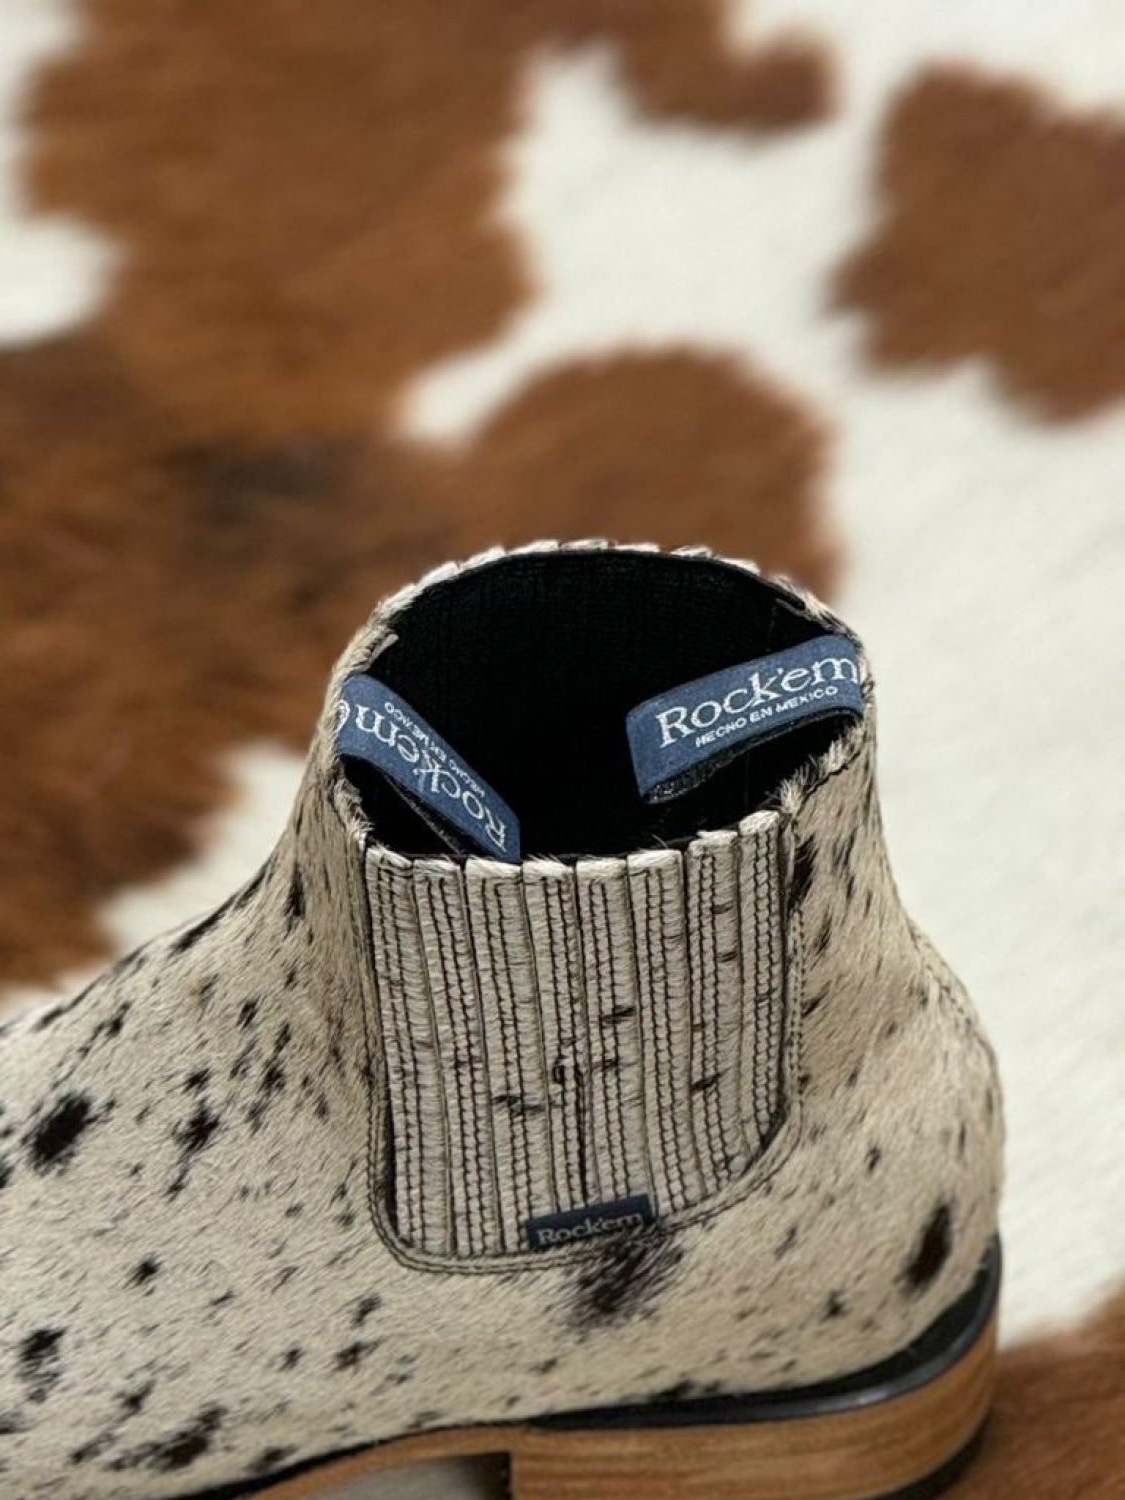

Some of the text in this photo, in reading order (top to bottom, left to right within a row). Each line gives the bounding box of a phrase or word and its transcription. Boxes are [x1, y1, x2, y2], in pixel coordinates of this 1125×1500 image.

[695, 685, 839, 748] HECHO EN MEXICO
